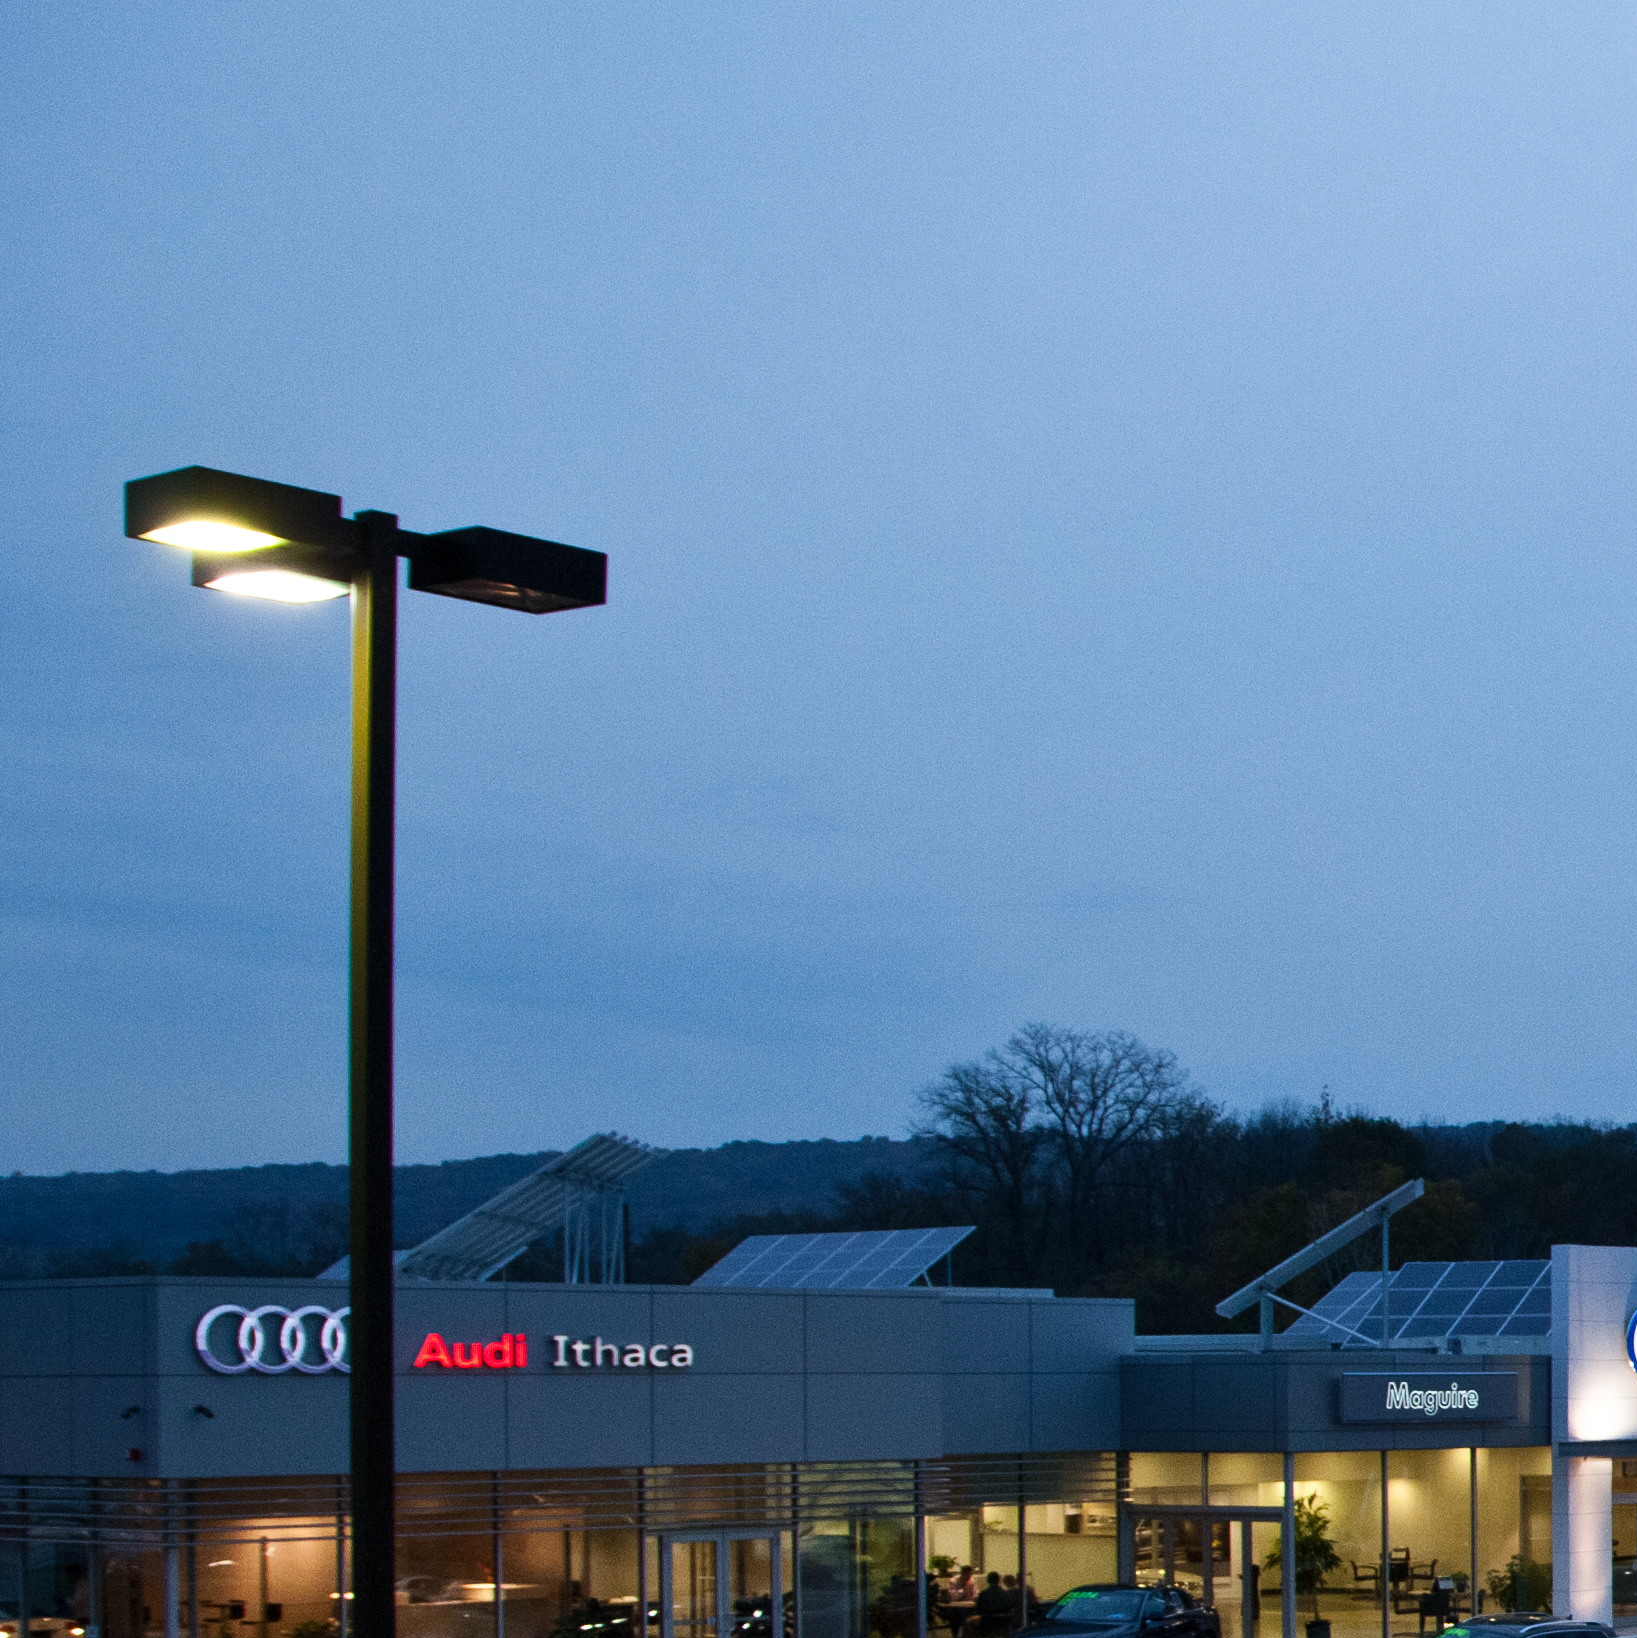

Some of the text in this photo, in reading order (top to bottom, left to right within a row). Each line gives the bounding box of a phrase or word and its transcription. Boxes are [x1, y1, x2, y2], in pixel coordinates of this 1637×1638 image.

[413, 1332, 694, 1368] Audi Ithaca
[1386, 1381, 1479, 1416] Maguire
